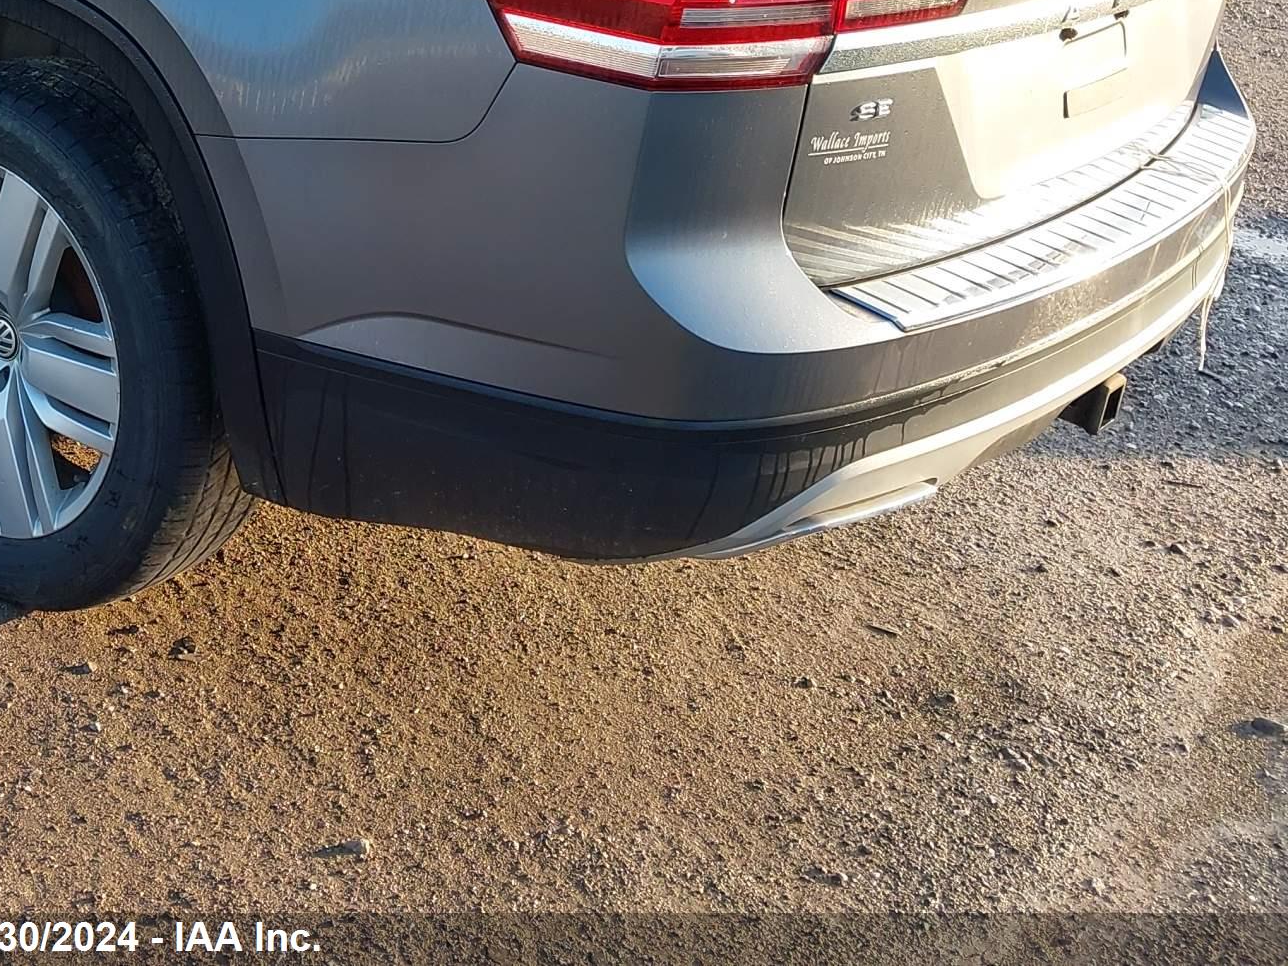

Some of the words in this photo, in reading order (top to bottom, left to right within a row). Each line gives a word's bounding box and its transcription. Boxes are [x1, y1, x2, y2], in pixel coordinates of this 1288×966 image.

[853, 98, 894, 121] SE
[810, 131, 851, 152] Wallace
[853, 131, 891, 153] Imports
[823, 157, 833, 165] OF
[833, 154, 863, 164] JOHNSON
